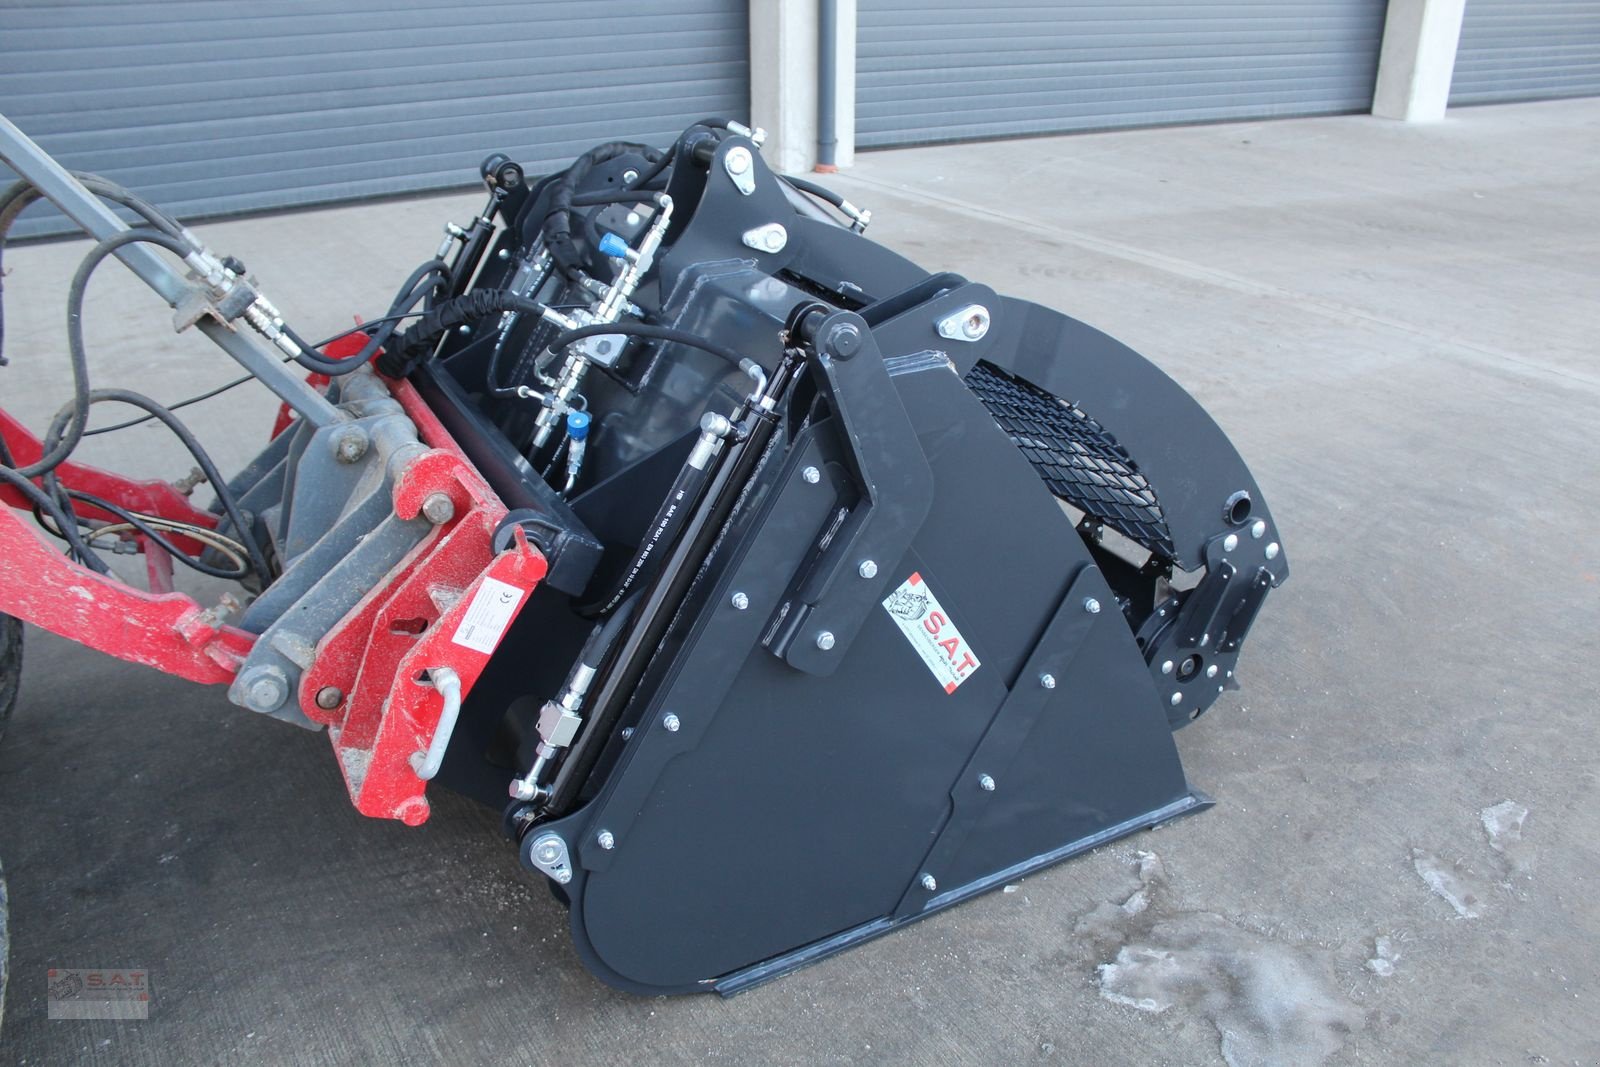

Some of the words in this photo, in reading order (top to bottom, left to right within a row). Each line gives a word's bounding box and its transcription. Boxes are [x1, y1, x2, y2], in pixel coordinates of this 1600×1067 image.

[666, 504, 677, 517] SAE
[660, 518, 669, 527] 100
[923, 610, 976, 677] S.A.T.
